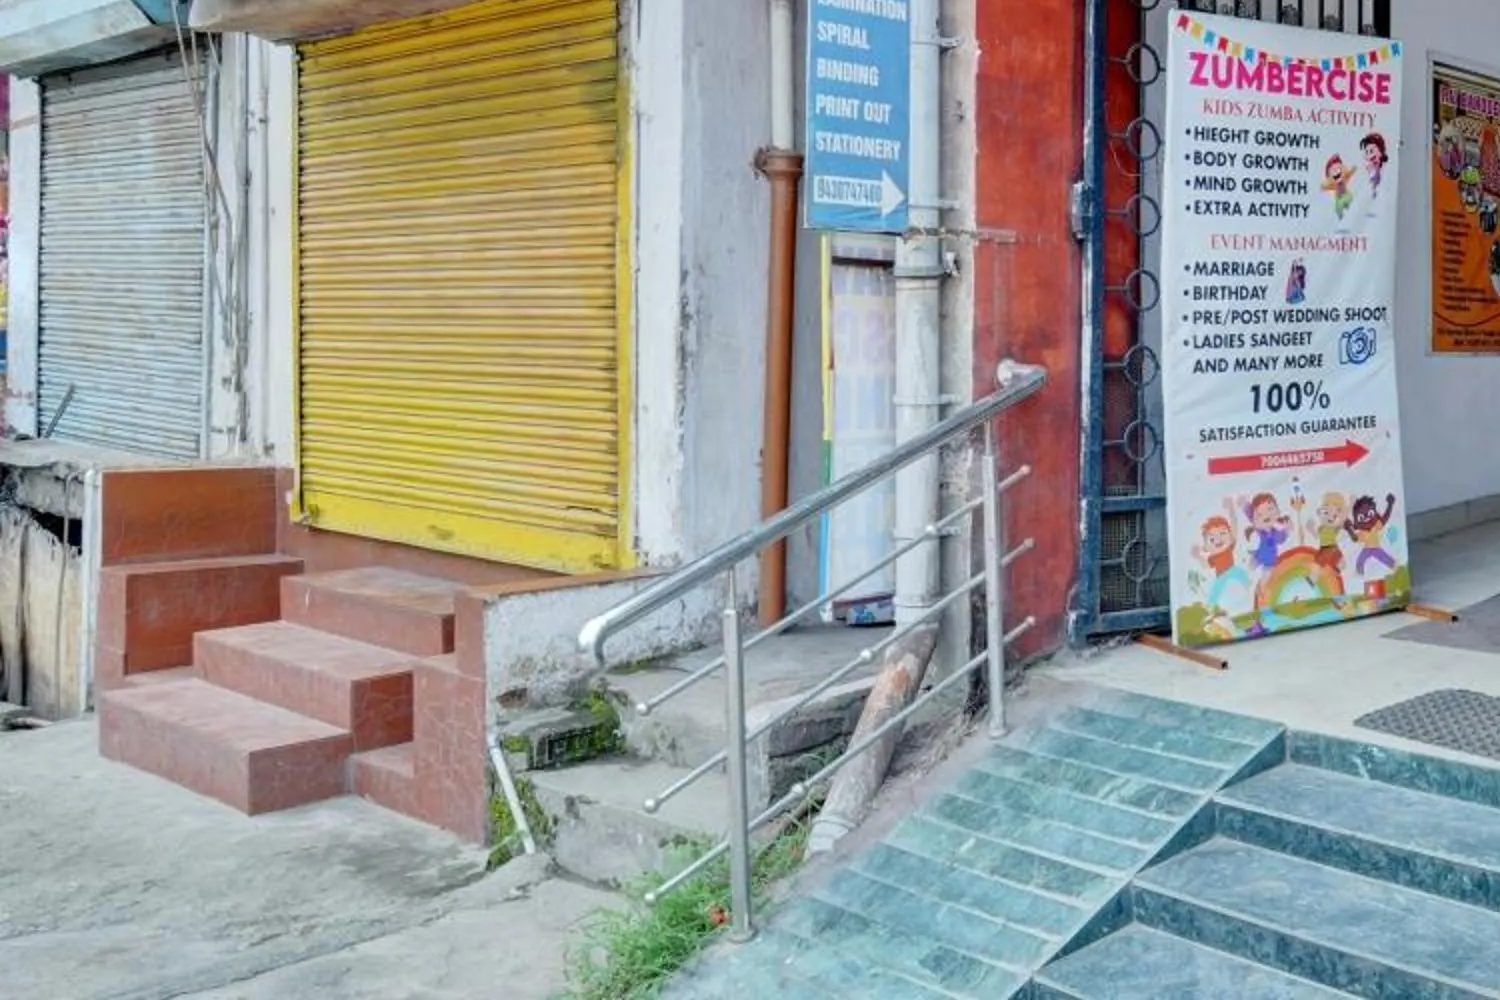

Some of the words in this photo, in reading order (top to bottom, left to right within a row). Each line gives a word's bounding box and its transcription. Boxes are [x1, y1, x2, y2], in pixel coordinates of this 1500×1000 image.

[817, 21, 871, 51] SPIRAL
[817, 58, 880, 87] BINDING
[1189, 50, 1391, 105] ZUMBERCISE
[815, 94, 860, 122] PRINT
[863, 101, 891, 125] OUT
[1202, 99, 1243, 116] KIDS
[1248, 101, 1303, 121] ZUMBA
[1308, 108, 1377, 128] ACTIVITY
[815, 131, 901, 161] STATIONERY
[1194, 126, 1250, 145] HIEGHT
[1254, 130, 1320, 149] GROWTH
[1193, 151, 1237, 168] BODY
[1242, 154, 1309, 172] GROWTH
[1193, 177, 1236, 193] MIND
[1241, 178, 1308, 195] GROWTH
[1194, 200, 1243, 216] EXTRA
[1247, 202, 1310, 219] ACTIVITY
[1211, 233, 1265, 251] EVENT
[1269, 234, 1368, 252] MANAGMENT
[1193, 261, 1275, 277] MARRIAGE
[1193, 285, 1269, 302] BIRTHDAY
[1193, 309, 1269, 326] PRE/POST
[1273, 307, 1340, 323] WEDDING
[1344, 306, 1388, 321] SHOOT
[1193, 332, 1246, 349] LADIES
[1250, 330, 1313, 347] SANGEET
[1193, 359, 1229, 374] AND
[1233, 356, 1279, 371] MANY
[1283, 354, 1324, 369] MORE
[1249, 379, 1331, 413] 100%
[1199, 421, 1297, 443] SATISFACTION
[1300, 415, 1377, 435] GUARANTEE
